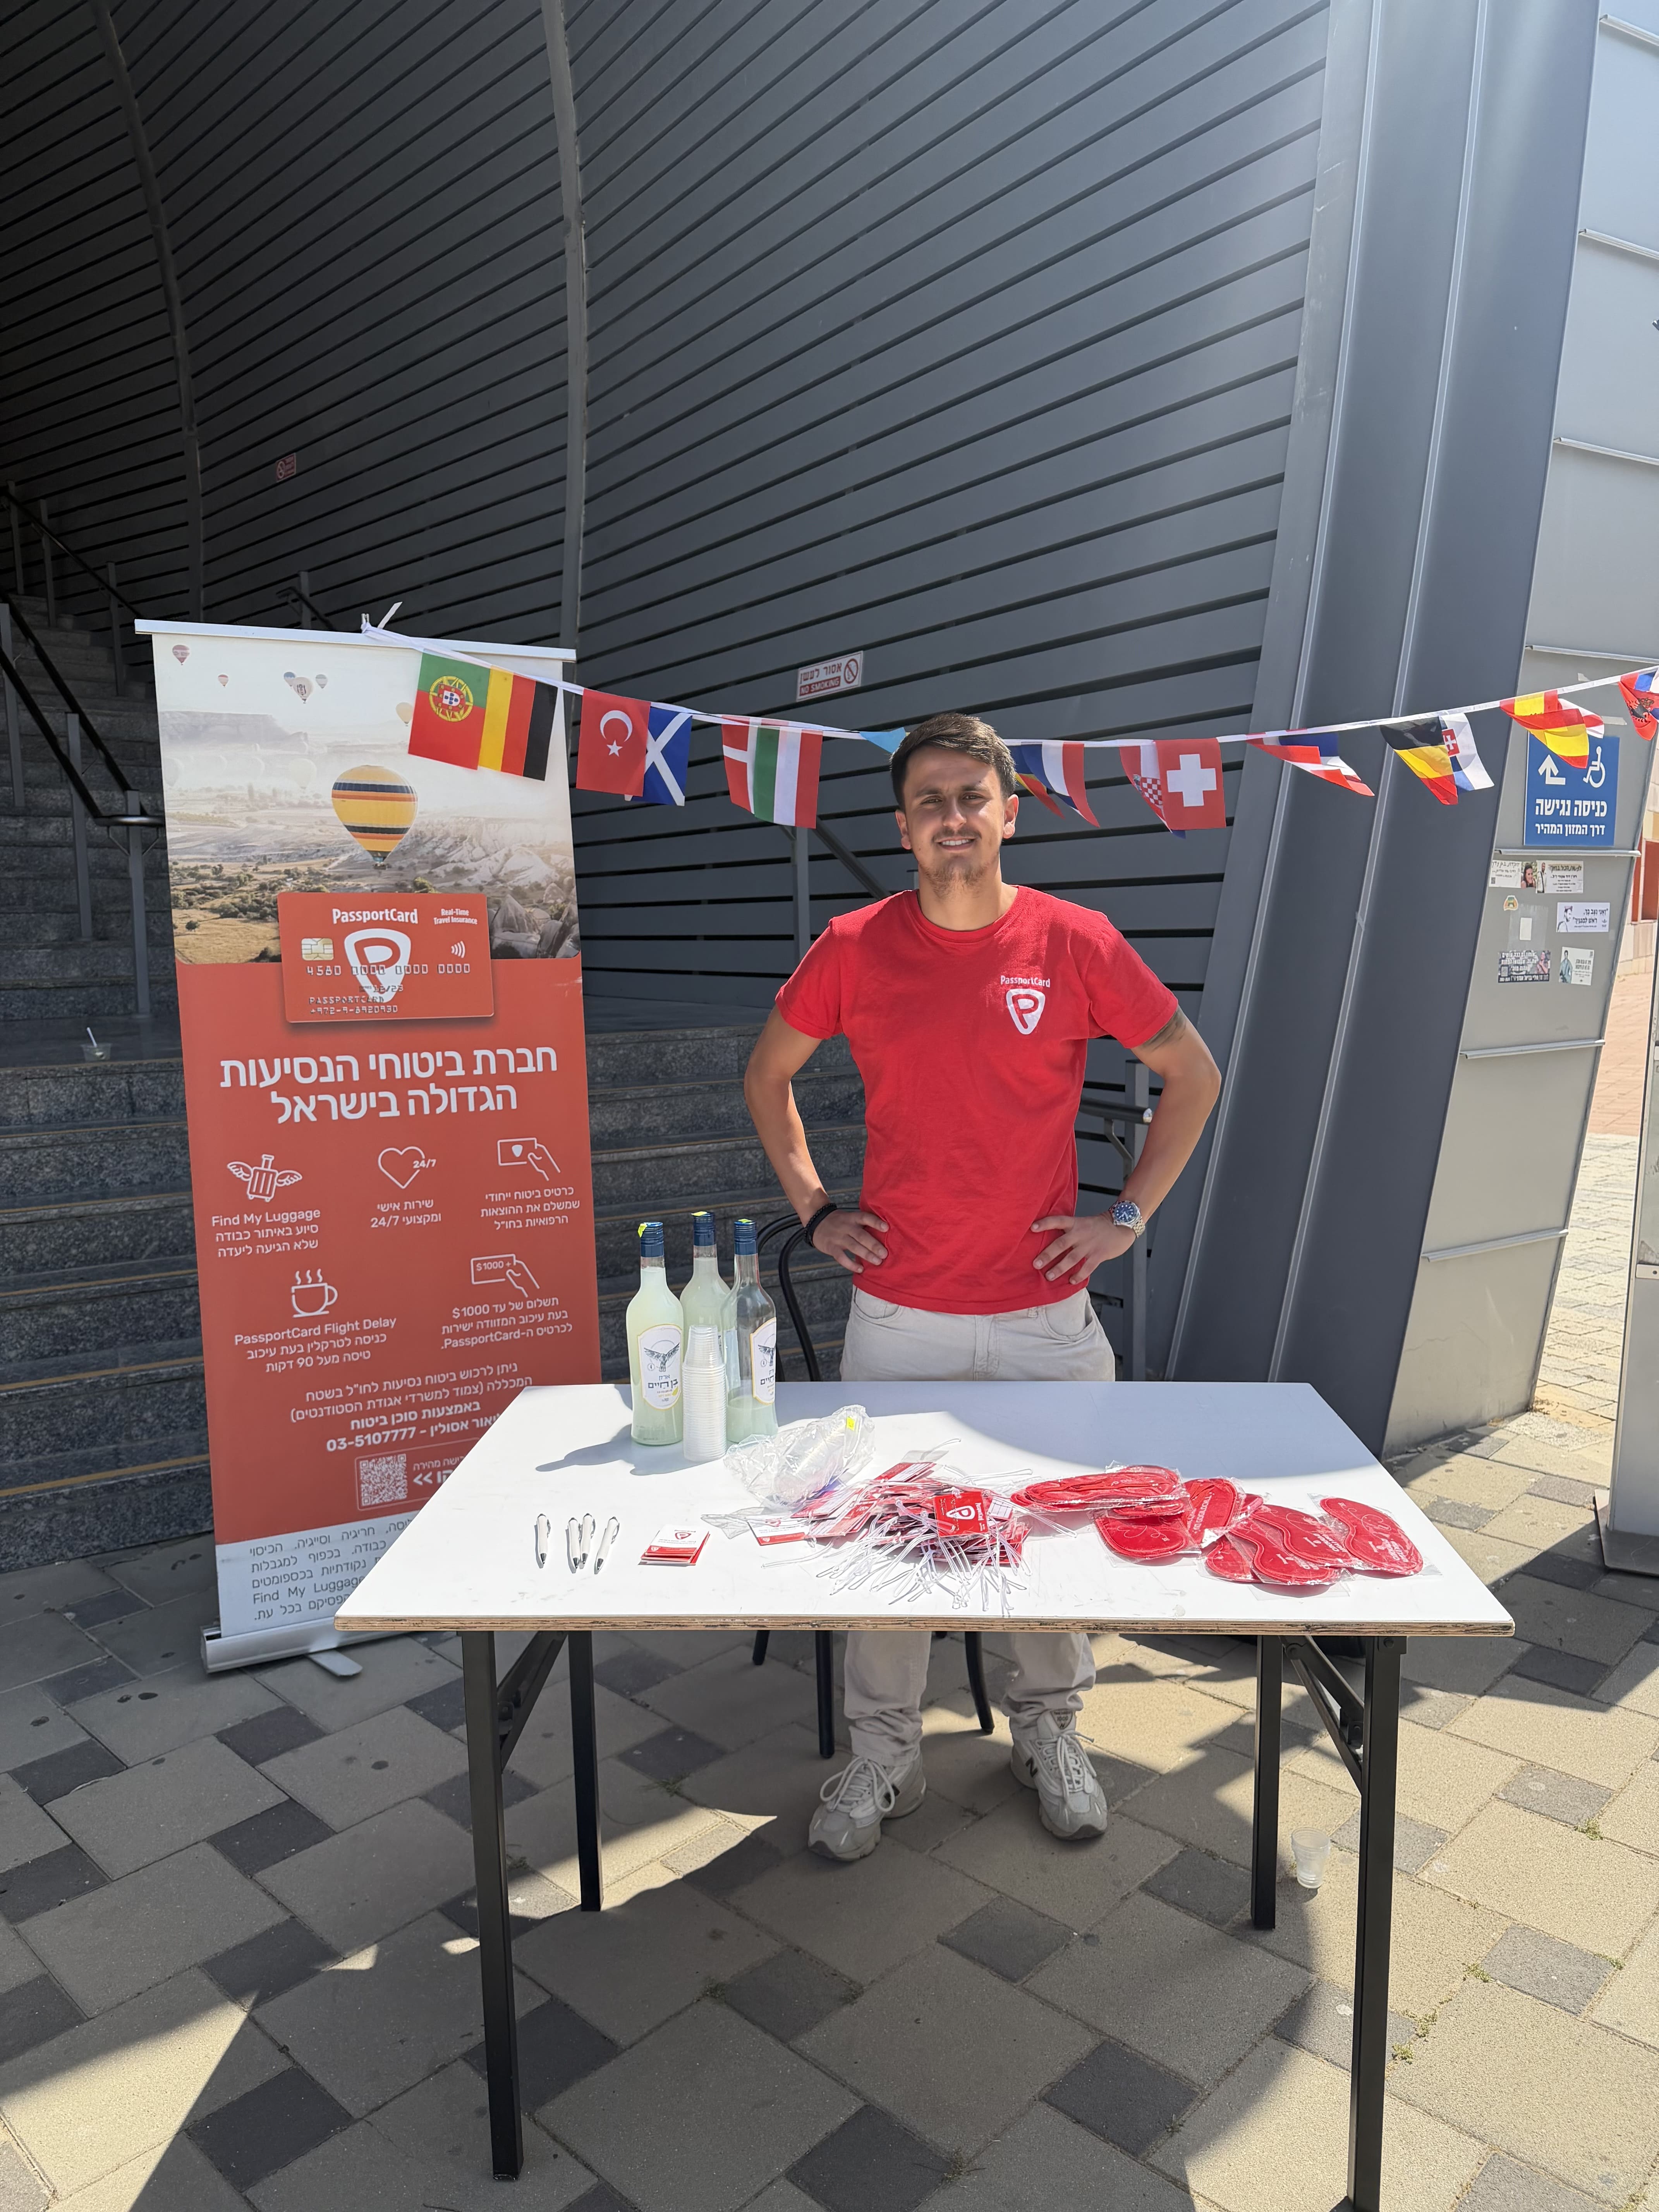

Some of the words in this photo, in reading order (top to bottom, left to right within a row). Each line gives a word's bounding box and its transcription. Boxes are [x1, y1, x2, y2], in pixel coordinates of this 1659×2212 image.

[823, 663, 842, 675] אסור
[800, 685, 809, 694] NO
[811, 678, 840, 691] SMOKING
[1535, 799, 1571, 816] נגישה
[1573, 800, 1607, 817] כניסה
[1535, 823, 1563, 835] המהיר
[1565, 824, 1588, 836] המזון
[1590, 824, 1605, 837] דרך
[332, 908, 419, 924] PassportCard
[441, 908, 470, 916] Real-Time
[433, 917, 450, 925] Travel
[451, 916, 478, 925] Insurance
[1000, 975, 1051, 988] PassportCard
[309, 995, 385, 1005] PASSPORTCARD
[369, 1051, 465, 1080] ביטוחי
[473, 1047, 557, 1075] חברת
[220, 1055, 359, 1088] הנסיעות
[407, 1082, 517, 1116] הגדולה
[270, 1091, 400, 1124] בישראל
[413, 1159, 436, 1168] 24/7
[485, 1192, 511, 1202] ייחודי
[514, 1190, 541, 1200] ביטוח
[544, 1187, 574, 1197] כרטיס
[377, 1202, 400, 1212] אישי
[404, 1199, 434, 1210] שירות
[481, 1205, 523, 1217] ההוצאות
[526, 1204, 541, 1213] את
[543, 1200, 580, 1212] שמשלם
[212, 1214, 240, 1227] Find
[244, 1213, 262, 1226] My
[265, 1209, 321, 1223] Luggage
[371, 1215, 399, 1228] 24/7
[402, 1213, 441, 1225] ומקצועי
[526, 1215, 568, 1227] הרפואיות
[254, 1227, 293, 1238] באיתור
[295, 1224, 319, 1235] סיוע
[216, 1231, 251, 1242] כבודה
[218, 1244, 252, 1257] ליעדה
[256, 1242, 290, 1254] הגיעה
[294, 1239, 318, 1250] שלא
[492, 1304, 506, 1313] עד
[508, 1301, 524, 1311] של
[526, 1297, 559, 1309] תשלום
[519, 1313, 544, 1324] עיכוב
[548, 1310, 568, 1321] בעת
[442, 1322, 473, 1335] ישירות
[476, 1317, 516, 1329] המזוודה
[536, 1322, 572, 1336] לכרטיס
[235, 1325, 321, 1345] PassportCard
[325, 1320, 360, 1335] Flight
[363, 1317, 397, 1330] Delay
[307, 1337, 351, 1353] לטרקלין
[355, 1333, 386, 1345] כניסה
[247, 1347, 276, 1360] עיכוב
[280, 1344, 304, 1355] בעת
[343, 1350, 371, 1362] טיסה
[297, 1356, 313, 1368] 90
[316, 1354, 340, 1365] מעל
[266, 1360, 294, 1373] דקות
[460, 1365, 493, 1379] לרכוש
[497, 1363, 518, 1376] ניתן
[383, 1377, 422, 1391] נסיעות
[425, 1372, 457, 1385] ביטוח
[487, 1376, 532, 1392] המכללה
[306, 1388, 343, 1402] בשטח
[405, 1388, 450, 1403] למשרדי
[367, 1396, 402, 1410] אגודת
[421, 1401, 481, 1419] באמצעות
[350, 1415, 388, 1430] ביטוח
[391, 1411, 418, 1425] סוכן
[430, 1420, 469, 1437] אסולין
[326, 1426, 416, 1452] 03-5107777
[413, 1460, 441, 1470] מהירה
[342, 1527, 375, 1540] חריגיה
[250, 1543, 283, 1556] הכיסוי
[308, 1549, 341, 1563] בכפוף
[252, 1555, 297, 1573] למגבלות
[321, 1559, 366, 1576] נקודתיות
[252, 1570, 313, 1589] בכספומטים
[253, 1590, 279, 1604] Find
[288, 1586, 306, 1598] My
[280, 1603, 302, 1615] בכל
